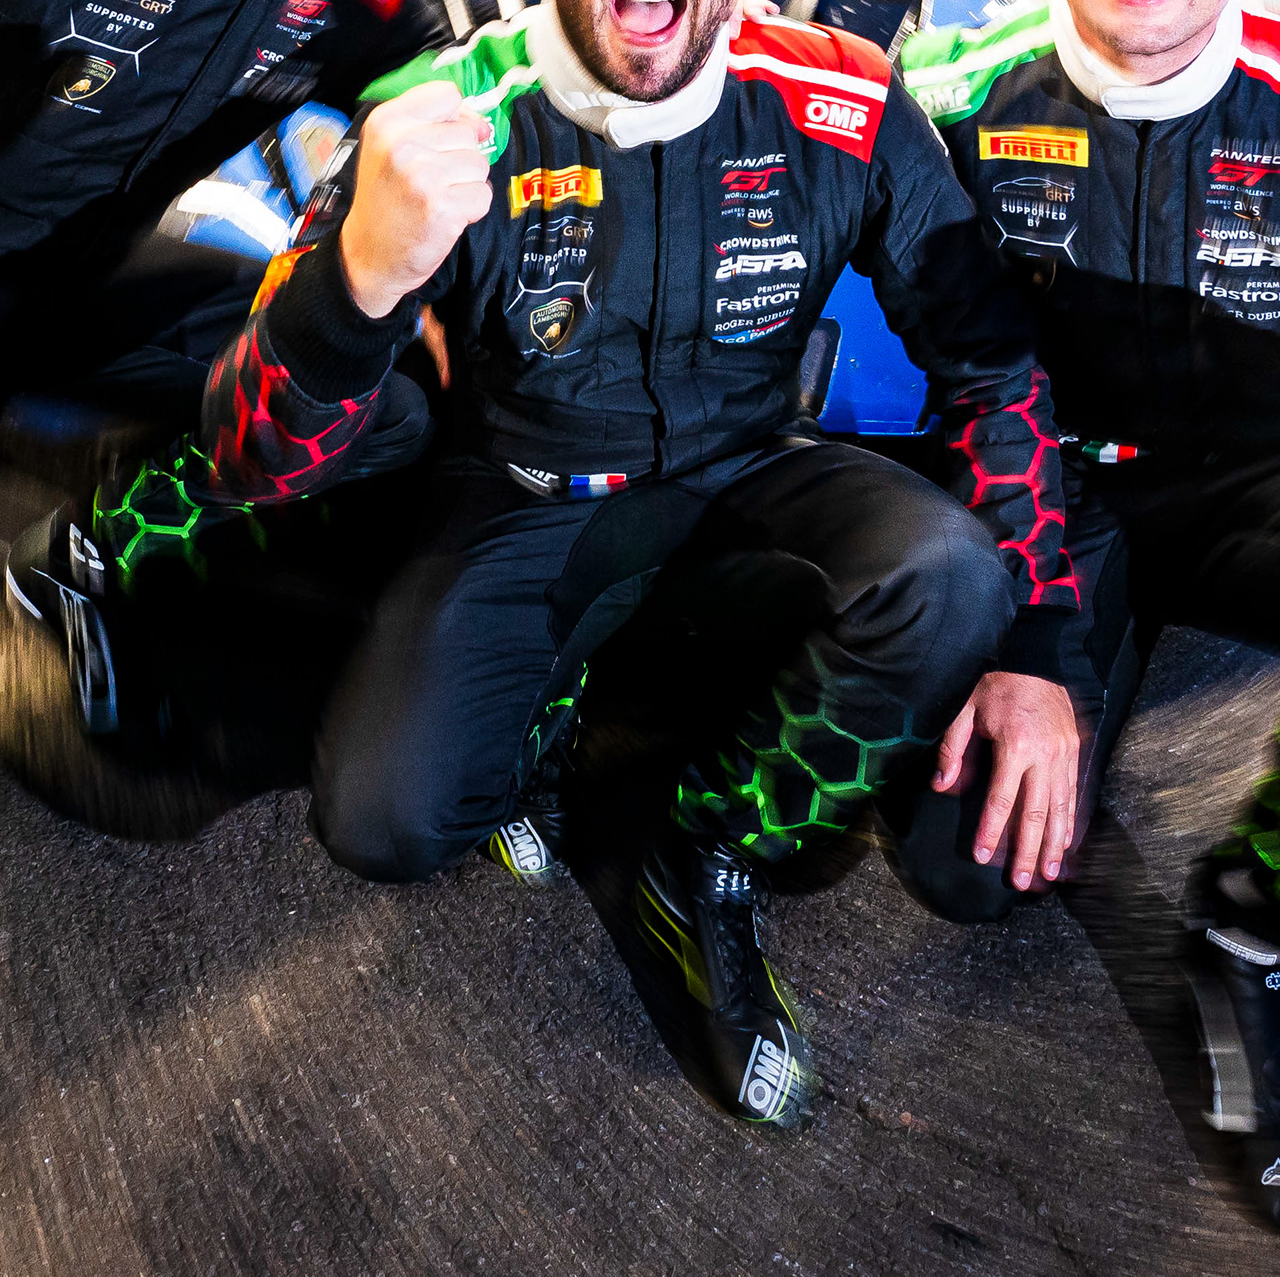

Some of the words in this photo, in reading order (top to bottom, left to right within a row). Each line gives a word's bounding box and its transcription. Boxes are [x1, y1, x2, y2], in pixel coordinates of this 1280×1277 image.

[85, 2, 155, 31] SUPPORTED
[105, 23, 124, 34] BY
[805, 100, 868, 132] OMP
[990, 136, 1079, 162] PIRELLI
[720, 153, 787, 169] FANATEC
[1209, 183, 1235, 191] WORLD
[724, 191, 749, 201] WORLD
[1045, 189, 1071, 203] GRT
[747, 207, 773, 220] aws
[1001, 203, 1067, 221] SUPPORTED
[1027, 218, 1041, 228] BY
[563, 225, 589, 239] GRT
[719, 234, 799, 252] CROWDSTRIKE
[523, 247, 587, 263] SUPPORTED
[548, 262, 560, 276] BY
[757, 282, 801, 294] PERTAMINA
[716, 290, 800, 314] Fastron
[714, 318, 754, 332] ROGER
[507, 822, 542, 871] OMP
[747, 1039, 784, 1110] OMP
